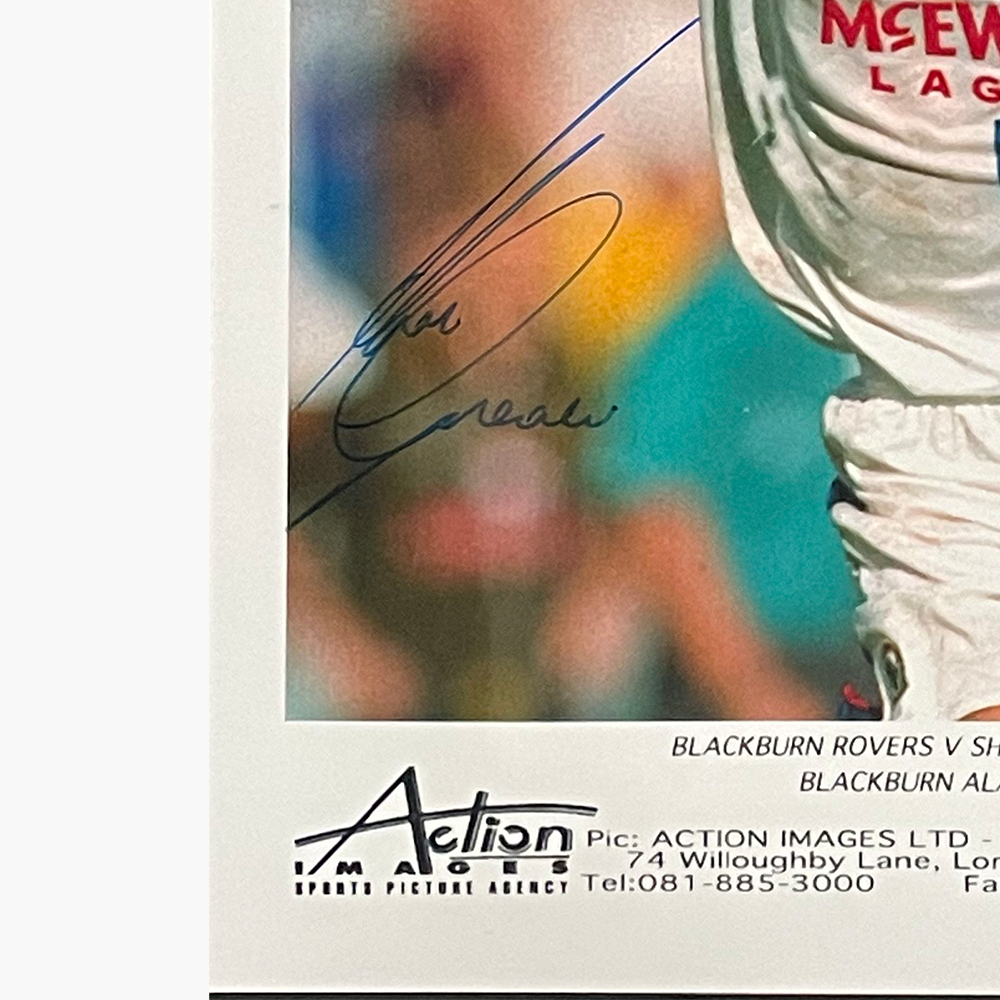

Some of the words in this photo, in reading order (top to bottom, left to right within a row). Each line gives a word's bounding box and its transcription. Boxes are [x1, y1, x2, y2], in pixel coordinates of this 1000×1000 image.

[671, 734, 825, 758] BLACKBURN
[831, 734, 935, 758] ROVERS
[945, 735, 964, 757] V
[799, 770, 955, 793] BLACKBURN
[294, 766, 598, 876] Action
[587, 829, 639, 848] Pic:
[651, 828, 768, 849] ACTION
[780, 828, 896, 849] IMAGES
[909, 829, 969, 849] LTD
[294, 859, 569, 876] IMAGES
[627, 850, 665, 870] 74
[679, 850, 847, 875] Willoughby
[858, 850, 940, 873] Lane,
[386, 880, 473, 896] PICTURE
[488, 879, 568, 896] AGENCY
[580, 872, 875, 893] Tel:081-885-3000
